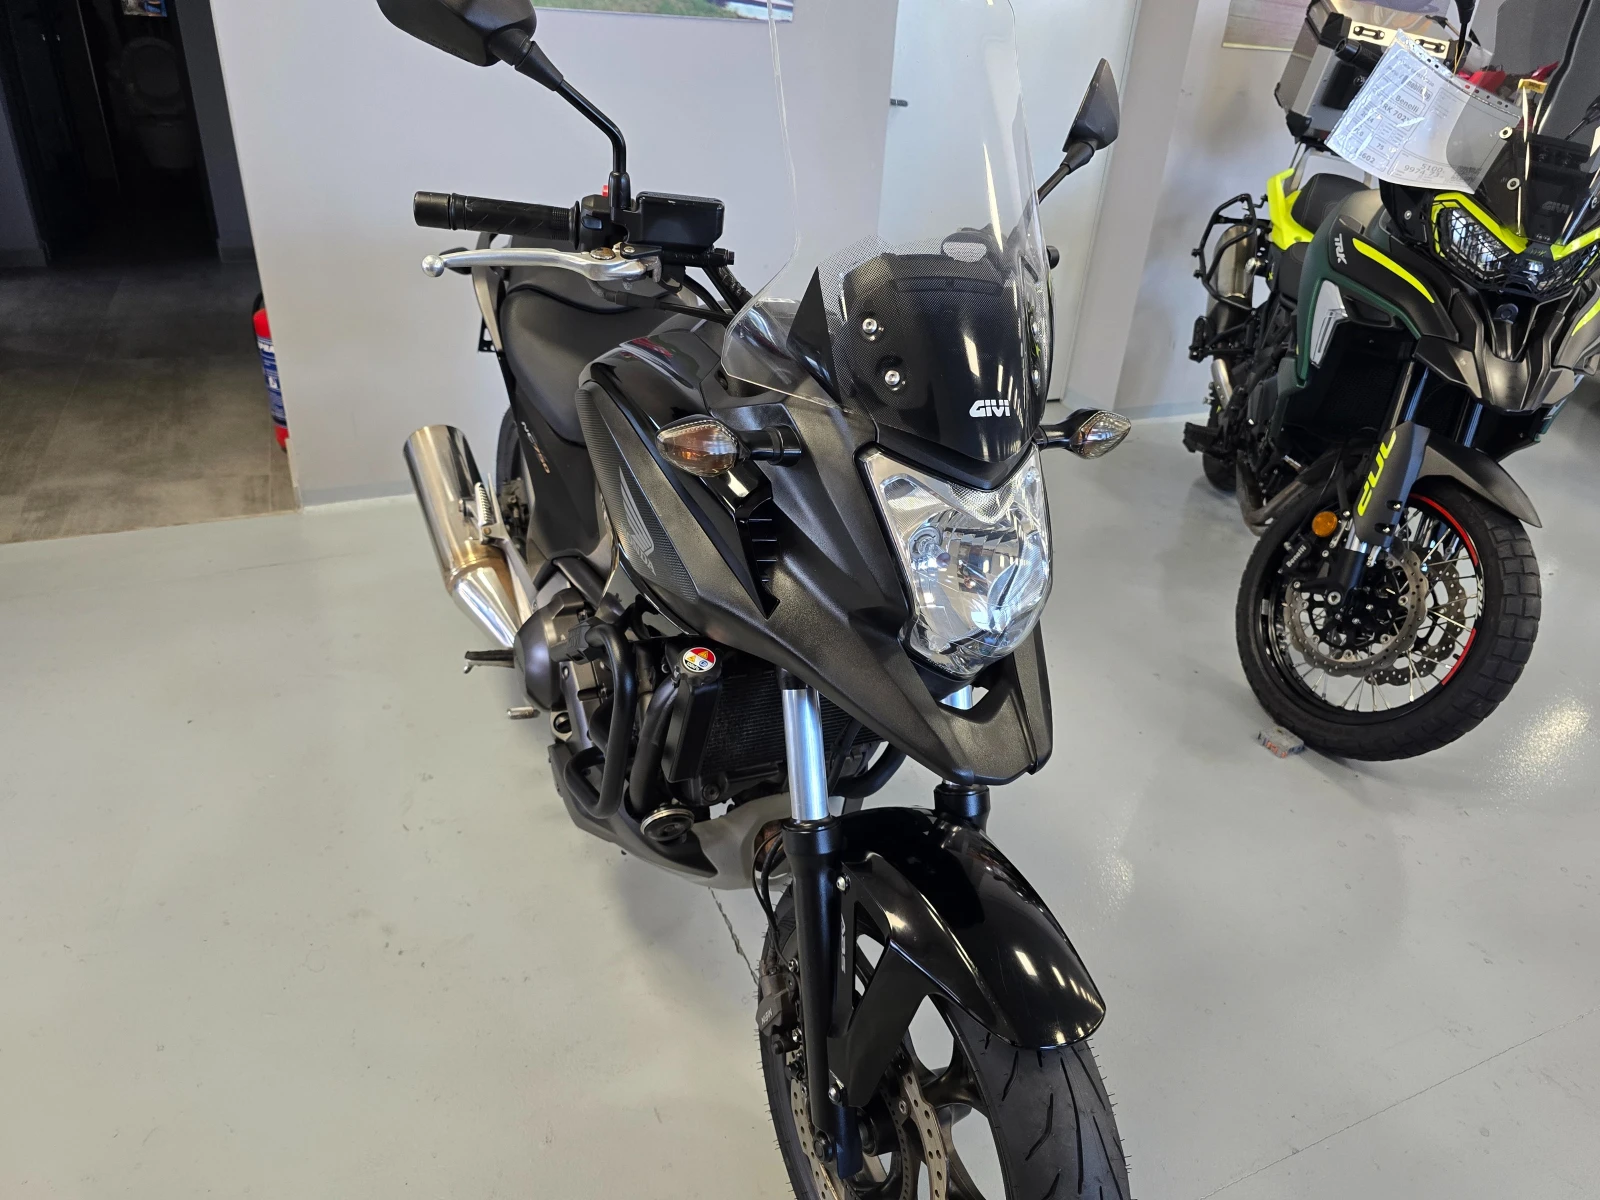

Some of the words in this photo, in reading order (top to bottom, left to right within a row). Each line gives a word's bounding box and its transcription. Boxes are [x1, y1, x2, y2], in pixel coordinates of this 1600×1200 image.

[1395, 94, 1420, 113] Benelli
[1334, 232, 1348, 265] TRK
[968, 399, 1011, 418] GIVI
[1285, 544, 1307, 568] Benelli
